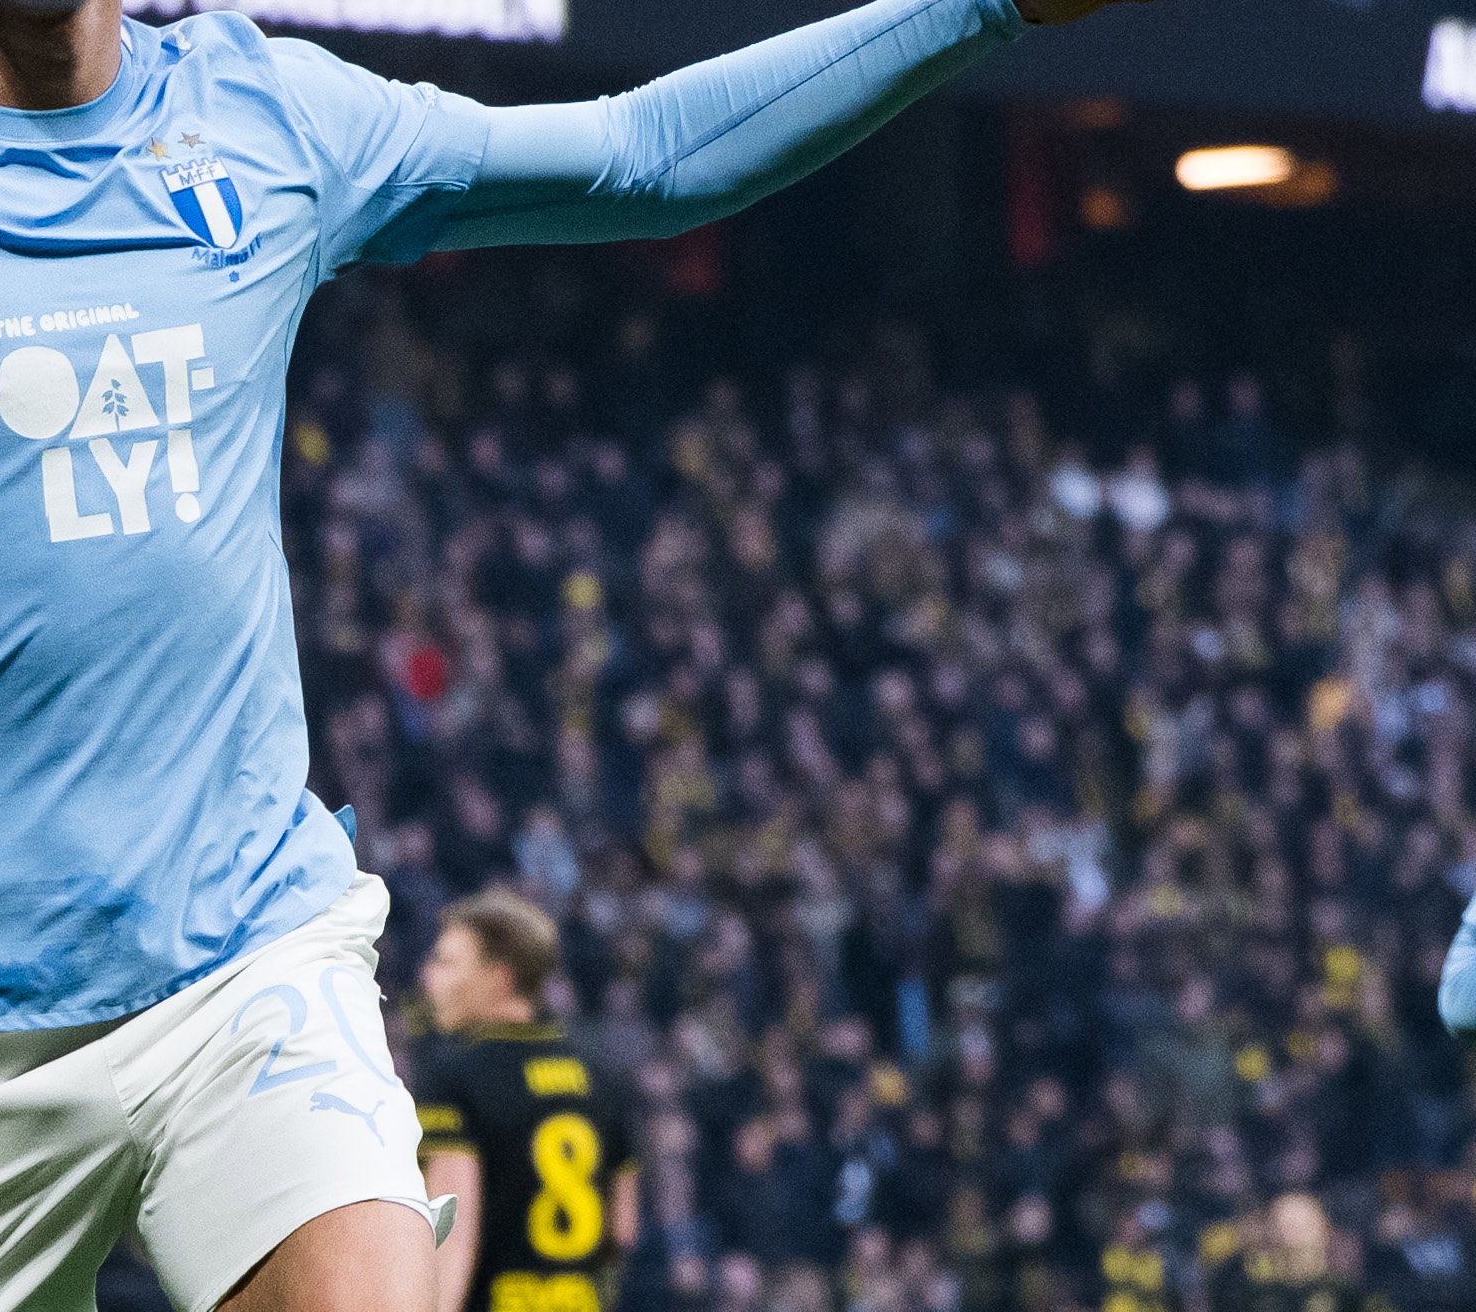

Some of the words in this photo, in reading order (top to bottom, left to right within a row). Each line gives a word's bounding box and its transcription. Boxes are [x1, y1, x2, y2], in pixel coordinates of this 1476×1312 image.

[39, 302, 140, 332] ORIGINAL
[41, 428, 201, 543] LY!
[527, 1112, 603, 1260] 8
